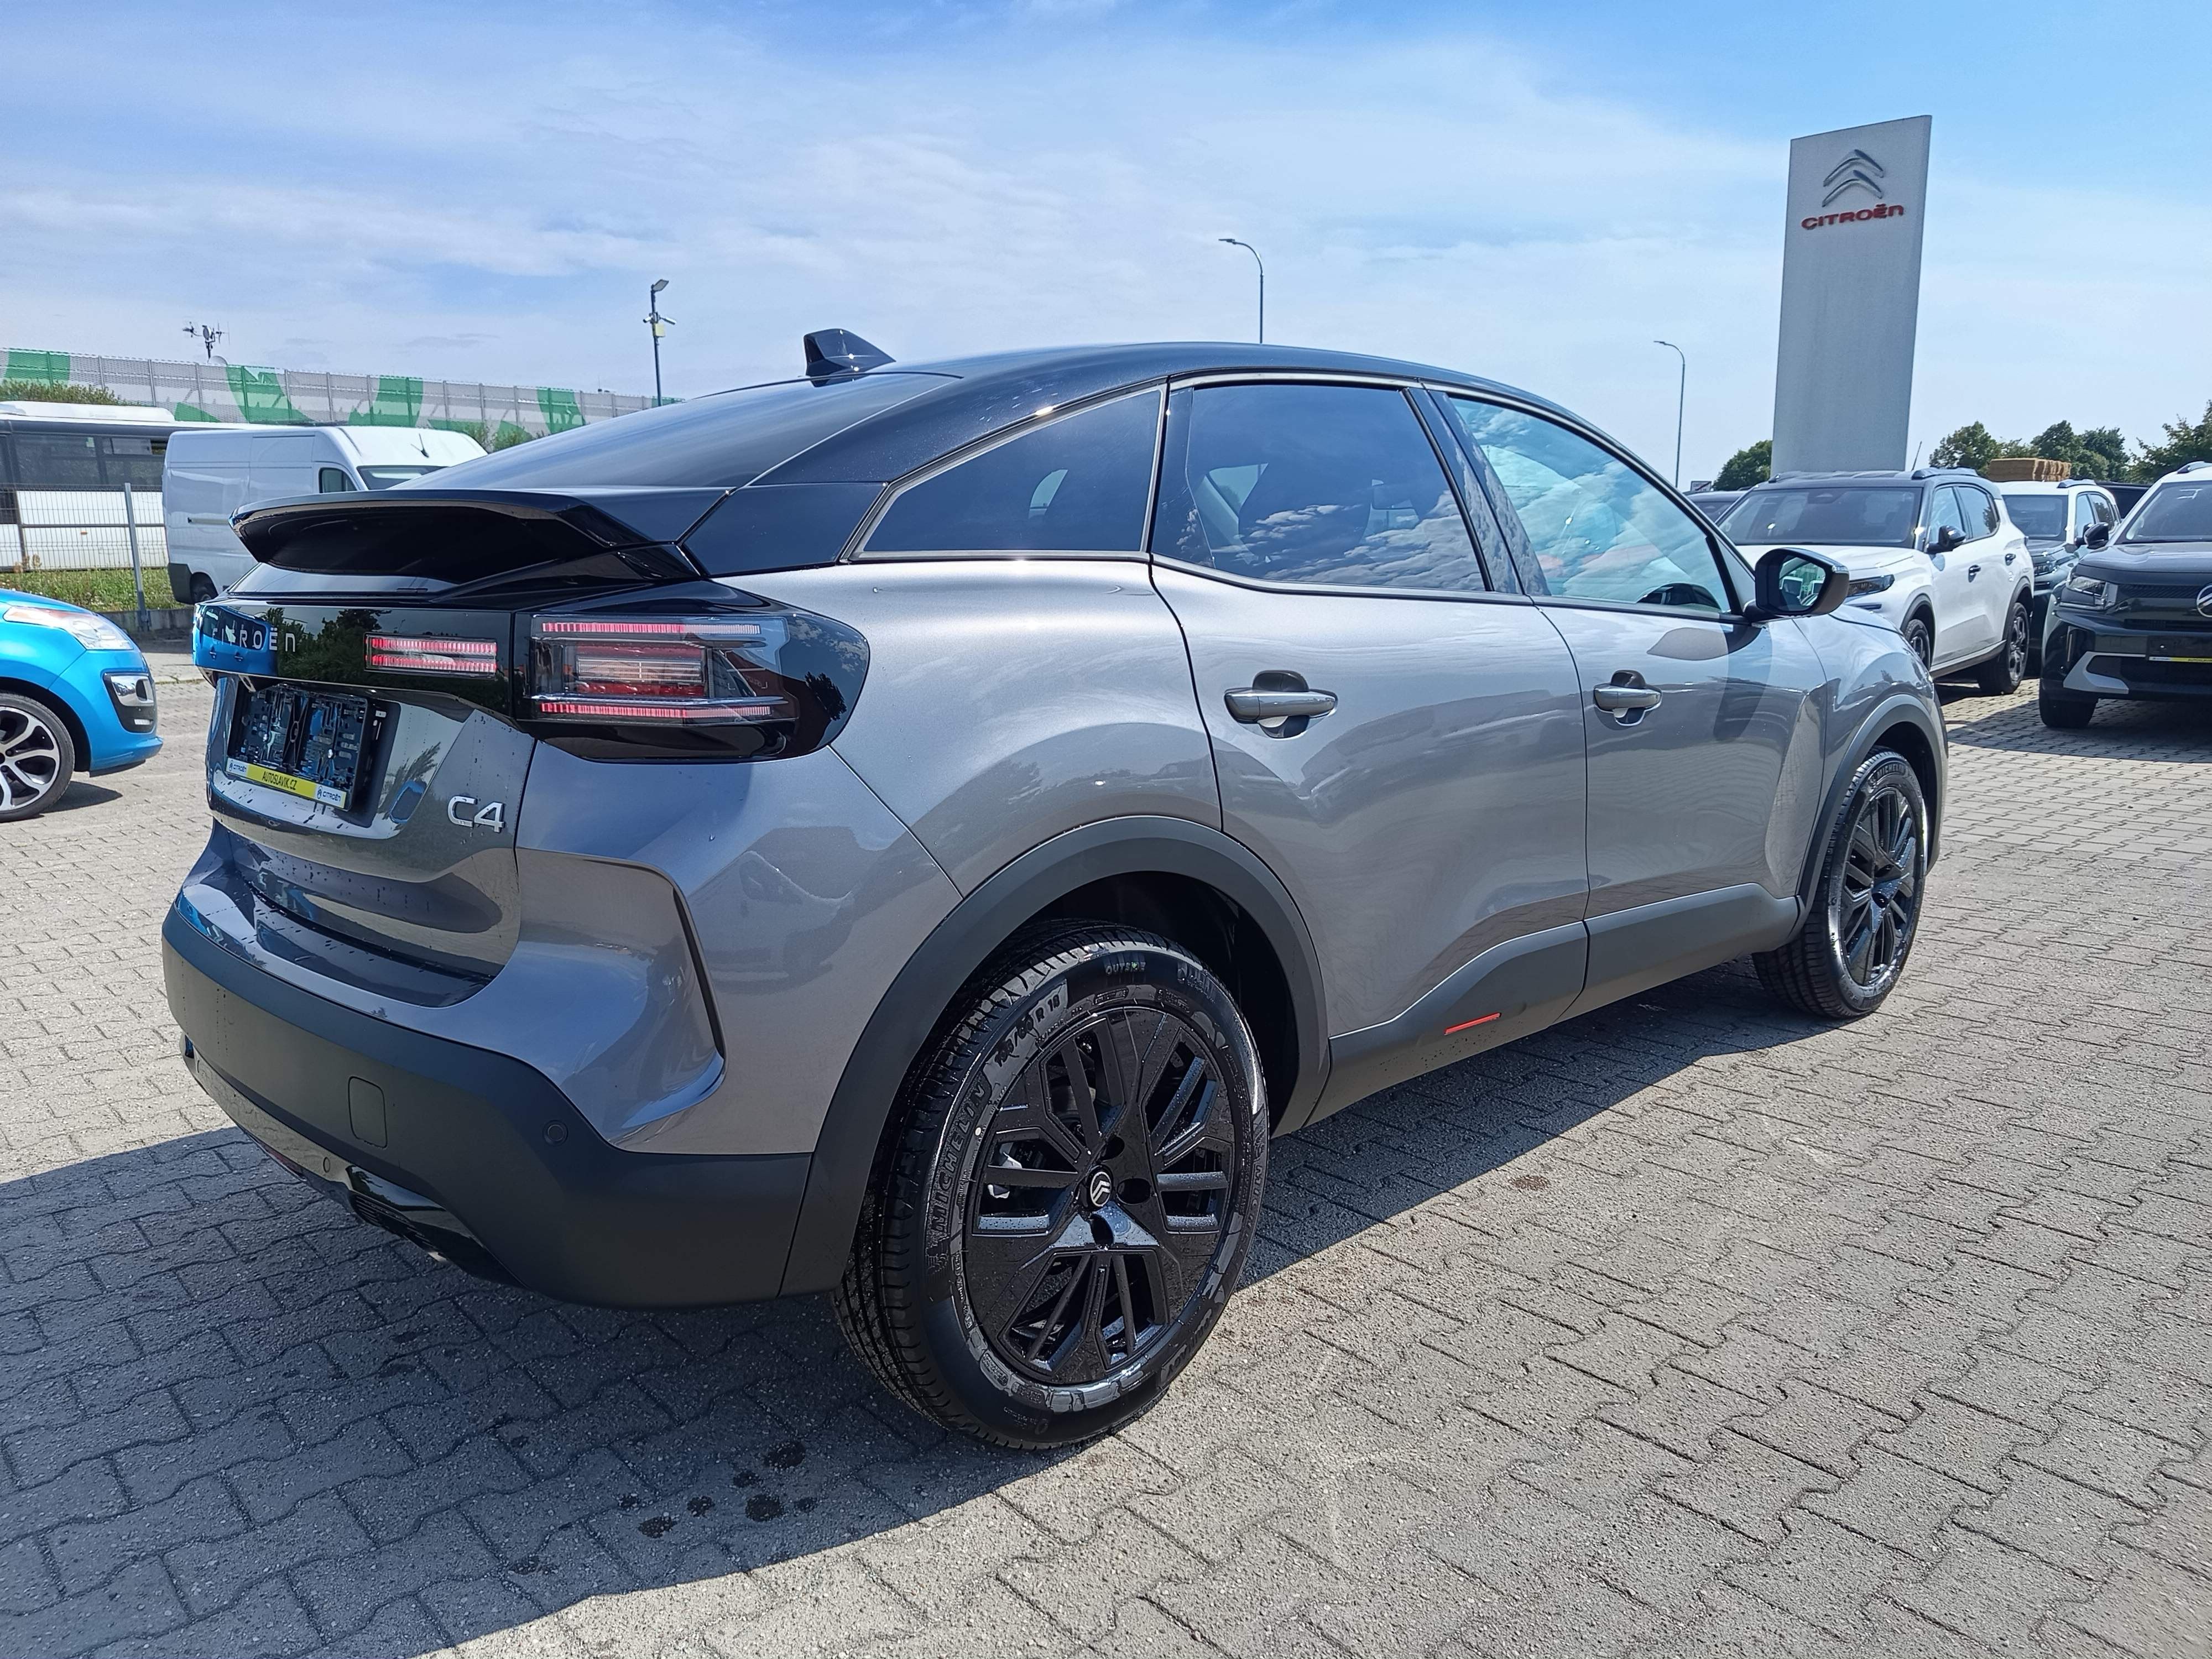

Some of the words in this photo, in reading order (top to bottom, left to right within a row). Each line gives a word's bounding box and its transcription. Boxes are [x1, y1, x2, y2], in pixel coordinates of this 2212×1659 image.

[1801, 204, 1904, 230] CITROËN
[262, 771, 298, 790] AUTOSLAVIK.CZ
[447, 795, 506, 833] C4
[931, 1082, 986, 1233] MICHELIN
